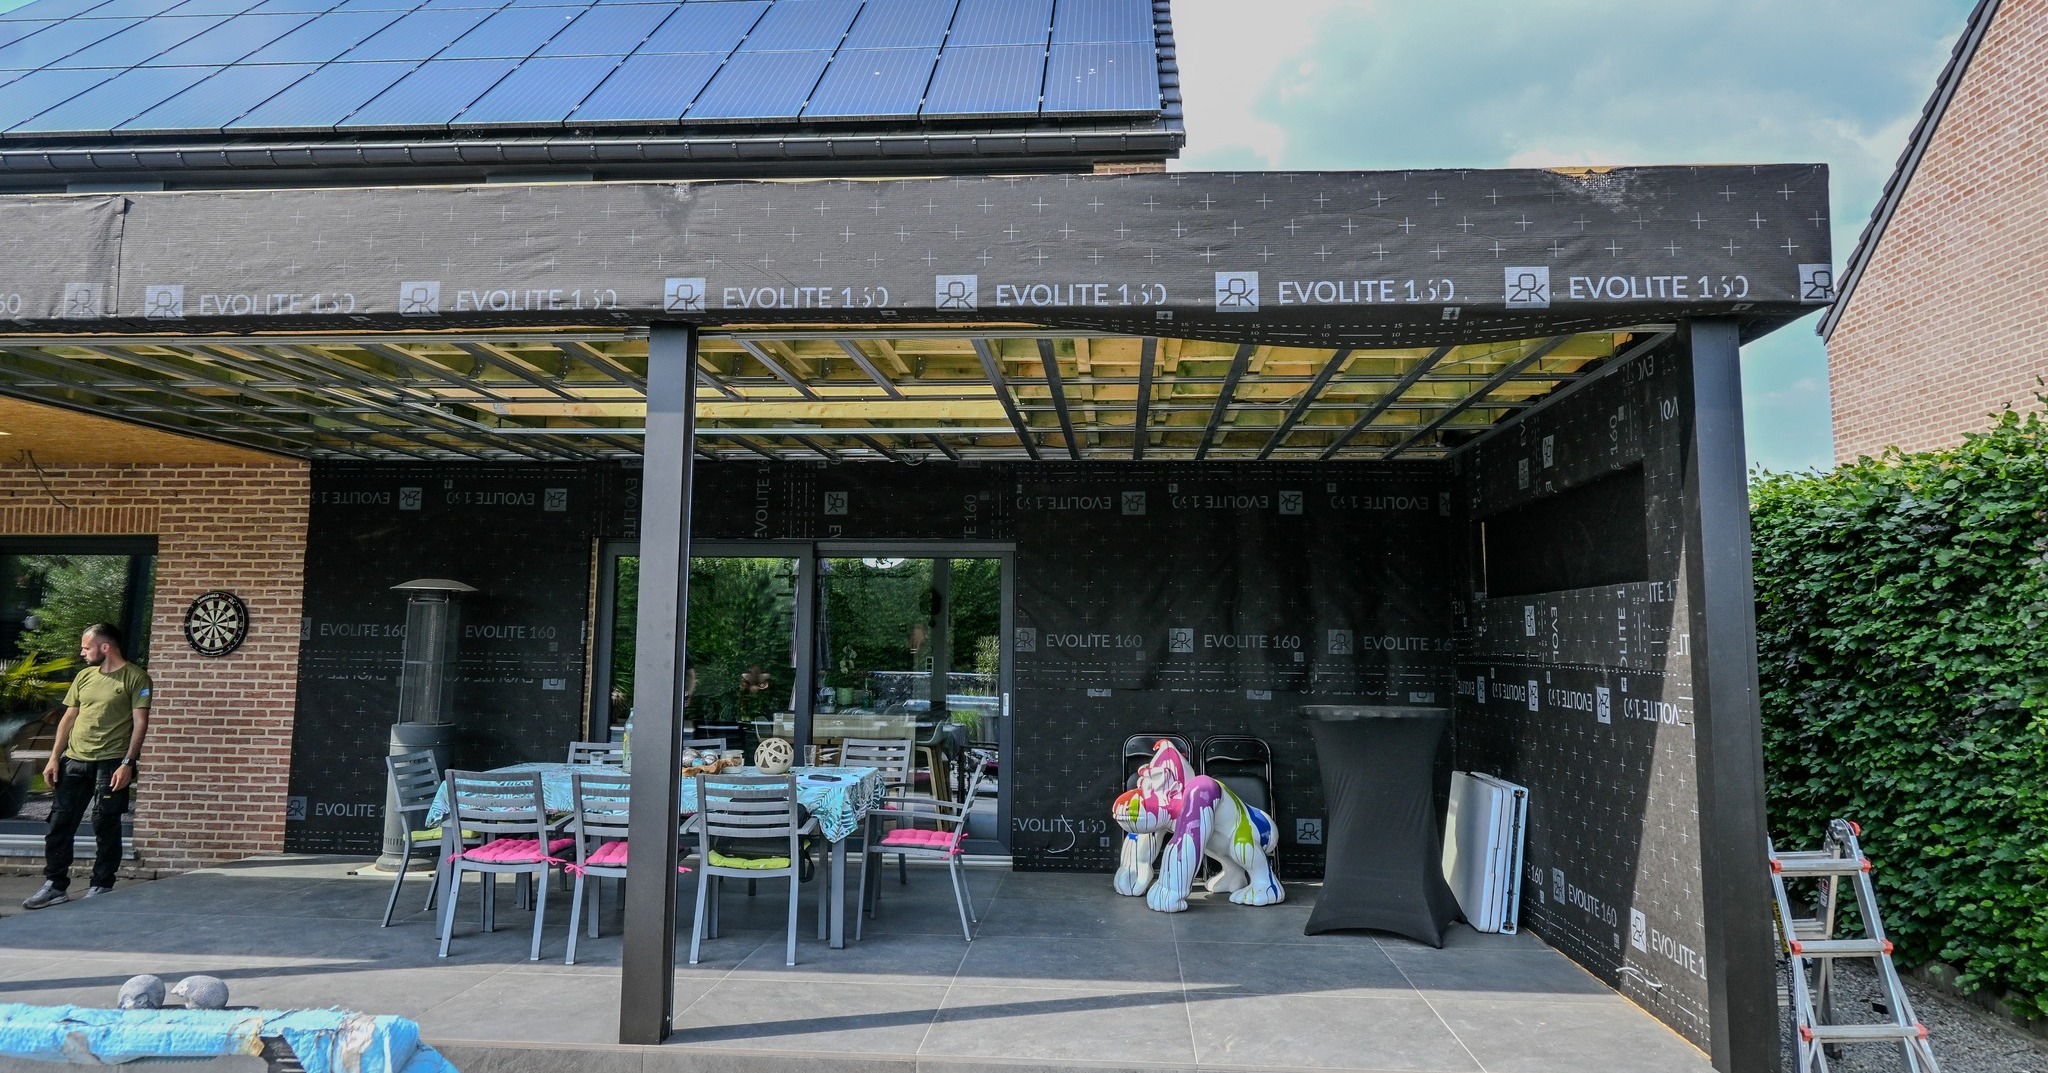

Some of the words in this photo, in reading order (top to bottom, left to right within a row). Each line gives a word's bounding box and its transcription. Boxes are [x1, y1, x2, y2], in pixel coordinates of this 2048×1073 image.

[997, 284, 1108, 306] EVOLITE
[1279, 281, 1395, 304] EVOLITE
[1569, 276, 1689, 299] EVOLITE
[200, 293, 303, 315] EVOLITE
[456, 289, 563, 311] EVOLITE
[723, 286, 833, 309] EVOLITE
[332, 491, 390, 505] EVOLITE
[475, 491, 535, 505] EVOLITE
[1048, 496, 1112, 510] EVOLITE
[1205, 495, 1268, 509] EVOLITE
[1363, 496, 1428, 510] EVOLITE
[320, 623, 379, 637] EVOLITE
[465, 625, 525, 640] EVOLITE
[530, 626, 556, 640] 160
[1046, 634, 1111, 648] EVOLITE
[1115, 634, 1142, 648] 160
[1204, 635, 1268, 649] EVOLITE
[1272, 635, 1300, 649] 160
[1364, 636, 1428, 651] EVOLITE
[1562, 690, 1593, 712] EVOLITE
[316, 803, 375, 818] EVOLITE
[1568, 883, 1600, 918] EVOLITE
[1601, 902, 1618, 928] 160
[1652, 928, 1697, 975] EVOLITE
